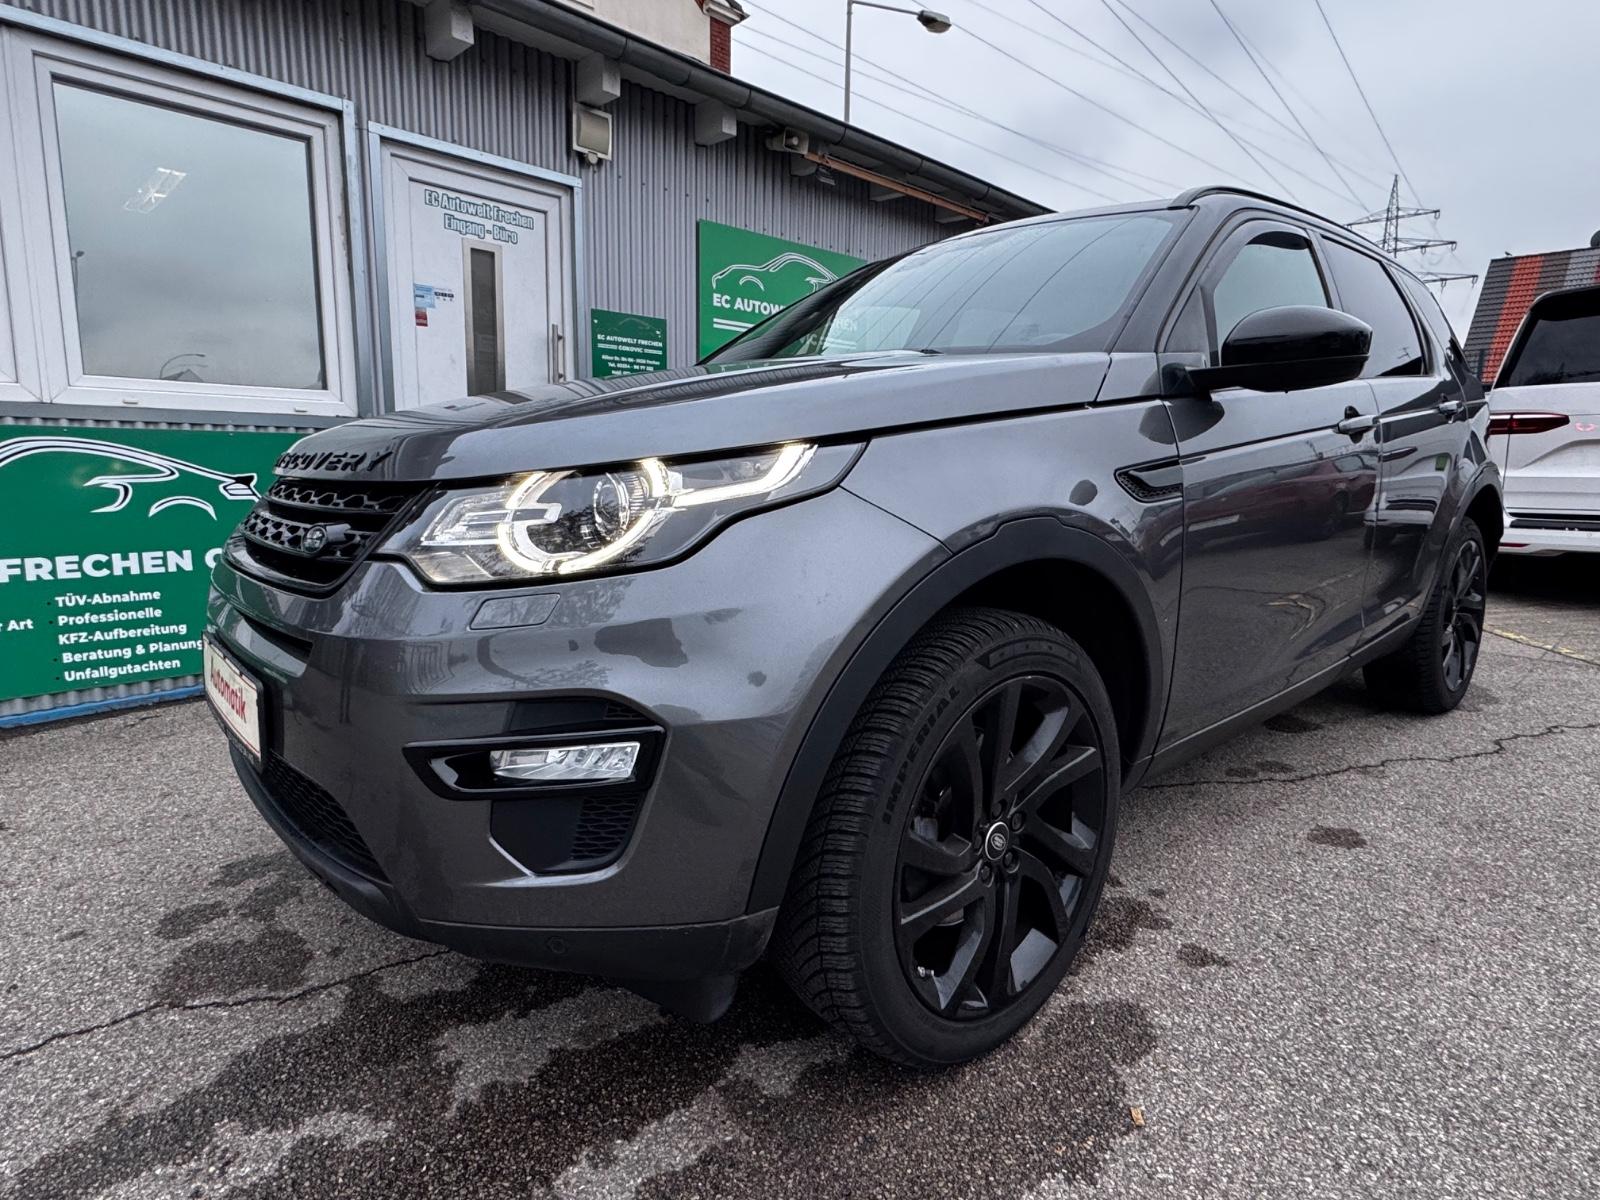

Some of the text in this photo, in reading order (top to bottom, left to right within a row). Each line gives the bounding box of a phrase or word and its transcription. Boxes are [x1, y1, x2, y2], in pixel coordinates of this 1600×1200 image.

[424, 188, 535, 230] EC Autowelt Frechen
[444, 213, 485, 240] Eingang
[492, 224, 518, 245] Büro
[713, 293, 785, 315] EC AUTOW
[606, 336, 637, 344] AUTOWELT
[637, 339, 663, 347] FRECHEN
[0, 550, 193, 583] FRECHEN
[55, 590, 161, 608] TÜV-Abnahme
[7, 618, 34, 632] Art
[57, 607, 163, 627] Professionelle
[58, 623, 188, 646] KFZ-Aufbereitung
[62, 645, 132, 664] Beratung
[135, 644, 146, 656] &
[64, 659, 181, 682] Unfallgutachten
[210, 654, 247, 724] Automatik
[882, 687, 960, 824] IMPERIAL
